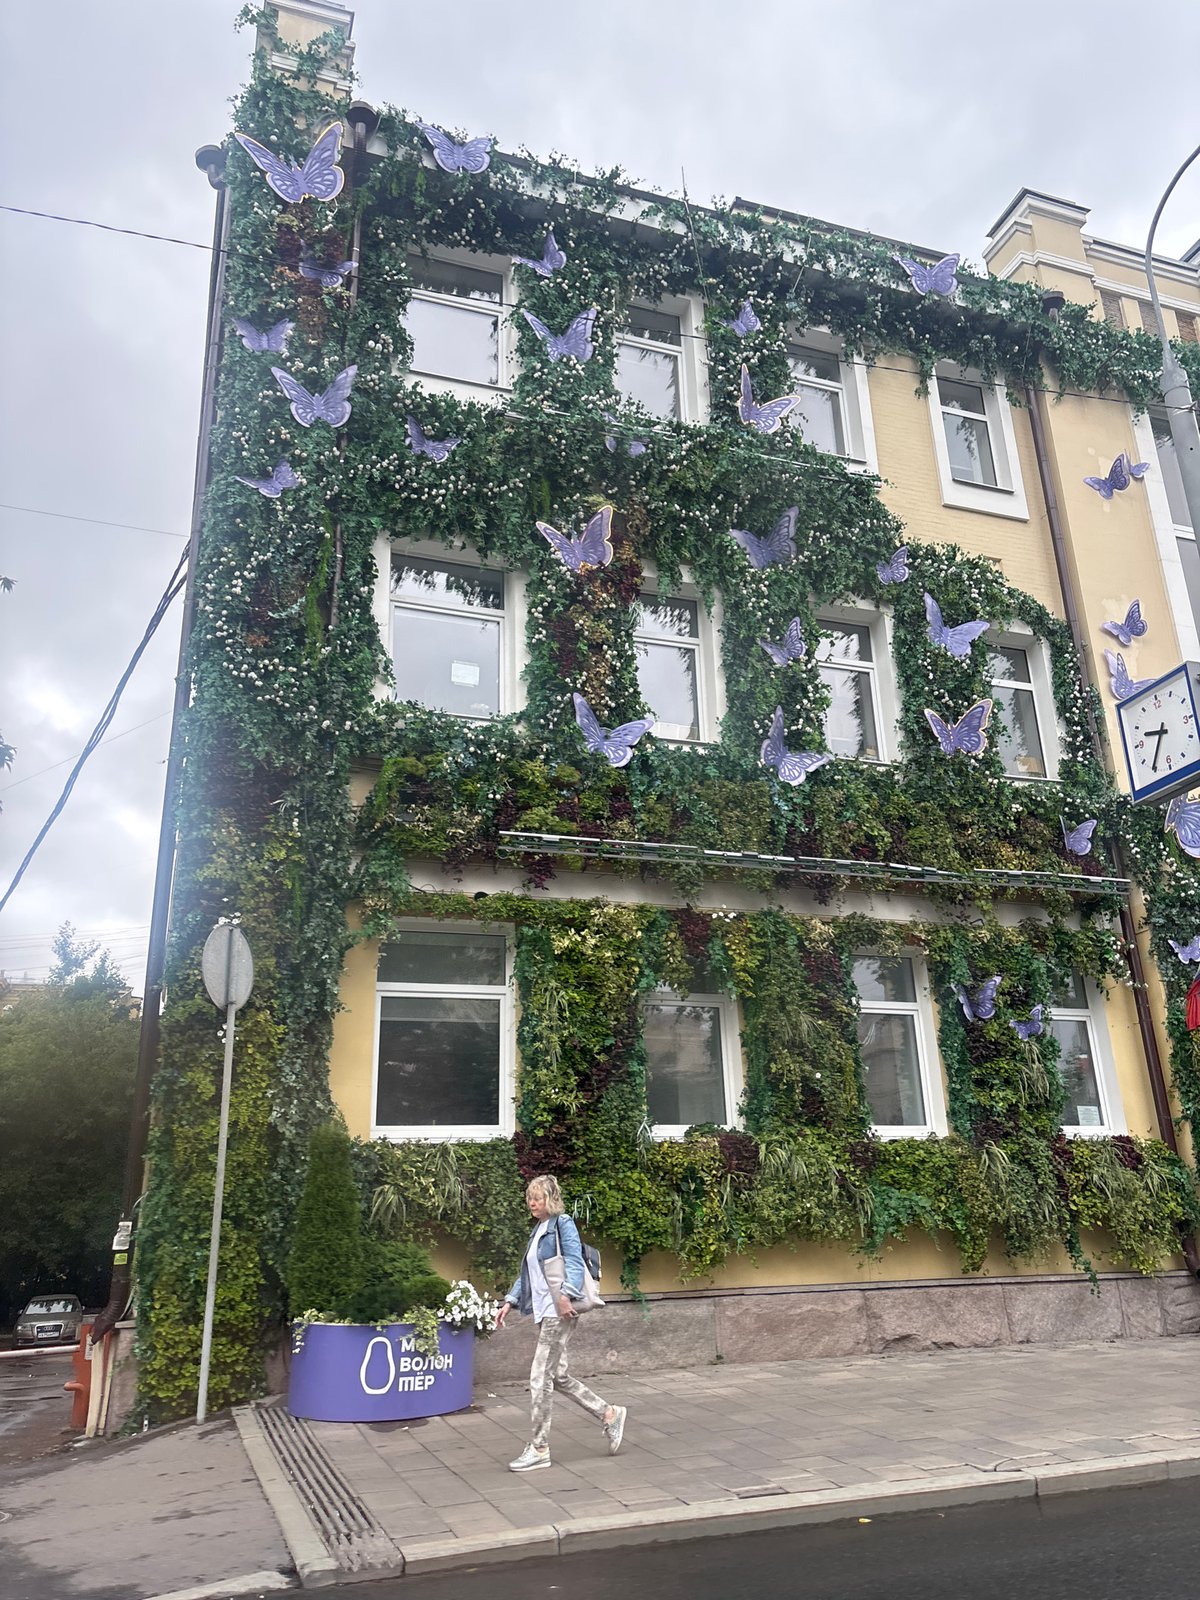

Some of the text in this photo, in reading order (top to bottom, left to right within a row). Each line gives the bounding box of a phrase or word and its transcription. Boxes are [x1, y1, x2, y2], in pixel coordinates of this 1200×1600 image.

[1153, 699, 1162, 710] 12
[1183, 715, 1189, 724] 3
[1138, 740, 1144, 749] 9
[1166, 755, 1172, 764] 6
[400, 1354, 453, 1372] ВОЛОН
